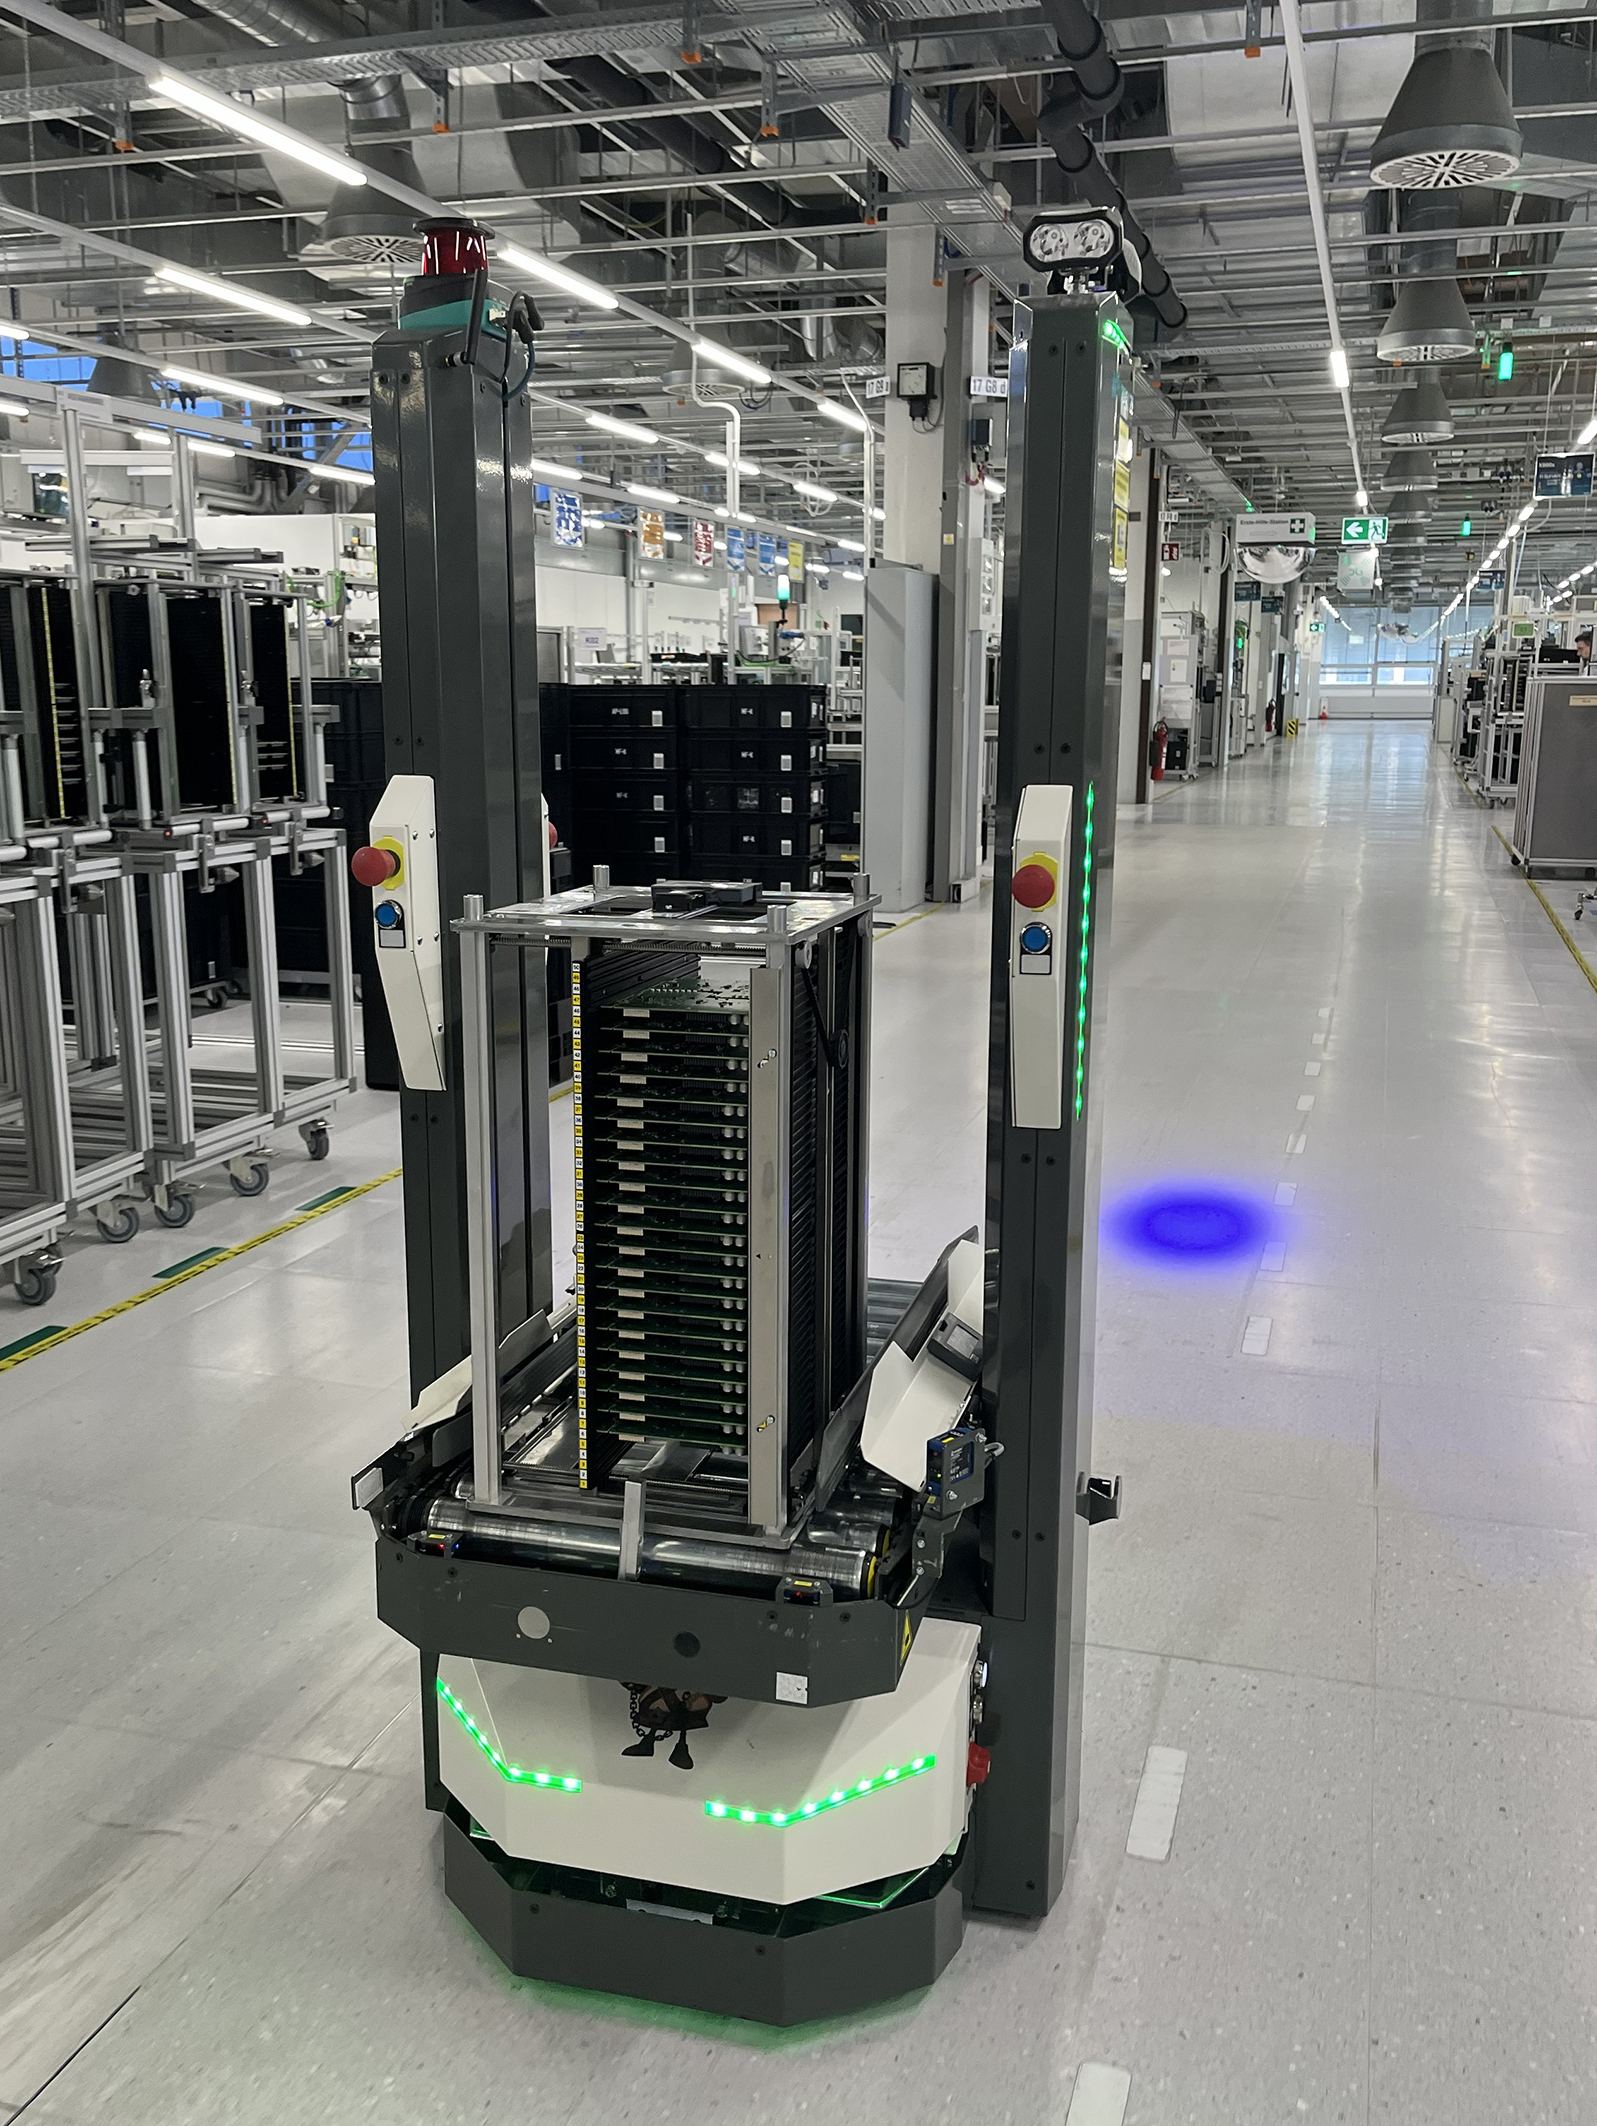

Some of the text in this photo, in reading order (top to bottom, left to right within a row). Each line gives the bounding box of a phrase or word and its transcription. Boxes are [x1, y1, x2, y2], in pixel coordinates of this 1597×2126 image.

[868, 382, 874, 395] 17
[972, 380, 1006, 394] 17 G8 d
